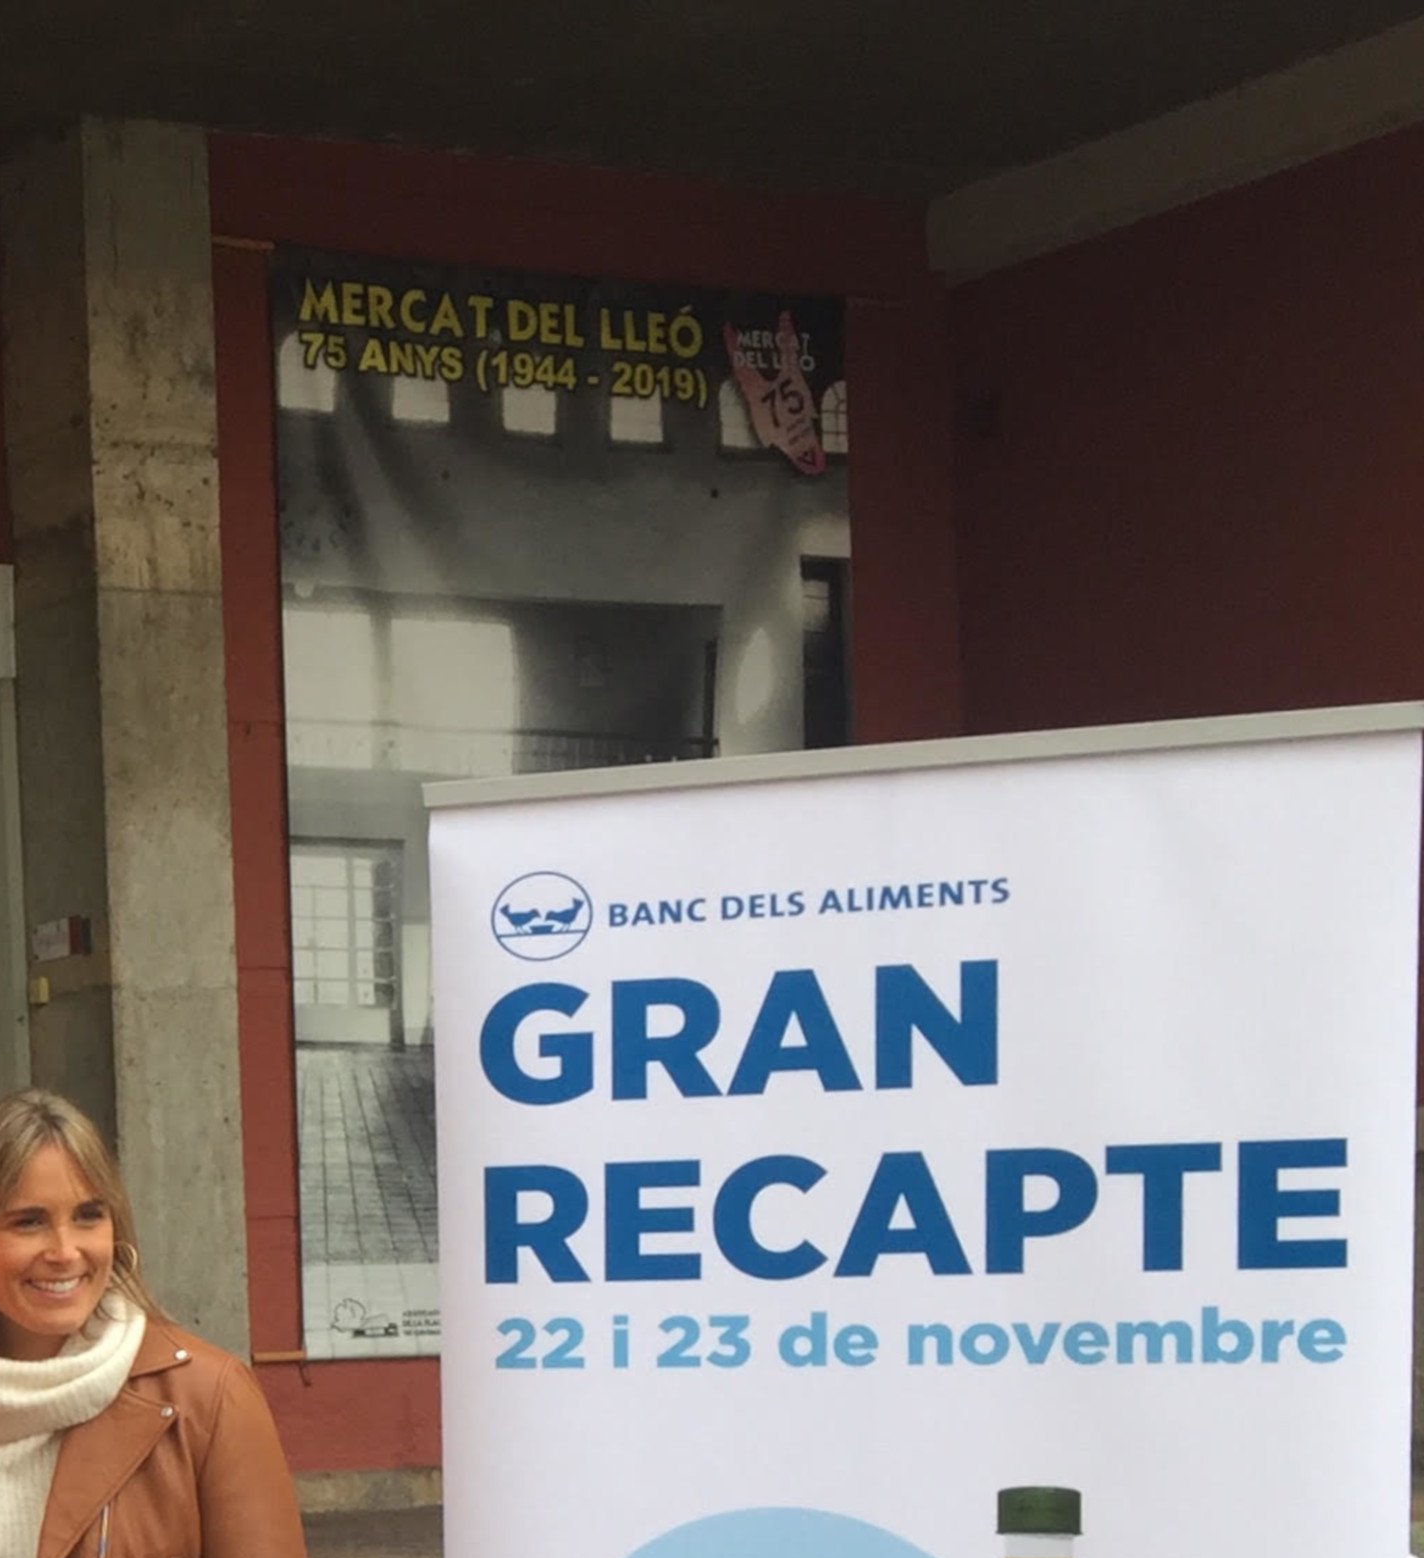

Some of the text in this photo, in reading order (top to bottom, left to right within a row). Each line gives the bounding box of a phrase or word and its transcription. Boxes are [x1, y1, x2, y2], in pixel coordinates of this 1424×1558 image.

[299, 279, 702, 358] MERCAT DEL LLEÓ
[299, 332, 347, 370] 75
[359, 343, 462, 380] ANYS
[476, 348, 576, 392] (1944
[611, 363, 707, 407] 2019)
[608, 876, 1010, 928] BANC DELS ALIMENTS
[479, 959, 1000, 1106] GRAN
[483, 1137, 1349, 1285] RECAPTE
[494, 1316, 586, 1370] 22
[610, 1314, 630, 1368] i
[656, 1314, 750, 1369] 23
[778, 1311, 879, 1368] de
[907, 1304, 1349, 1366] novembre
